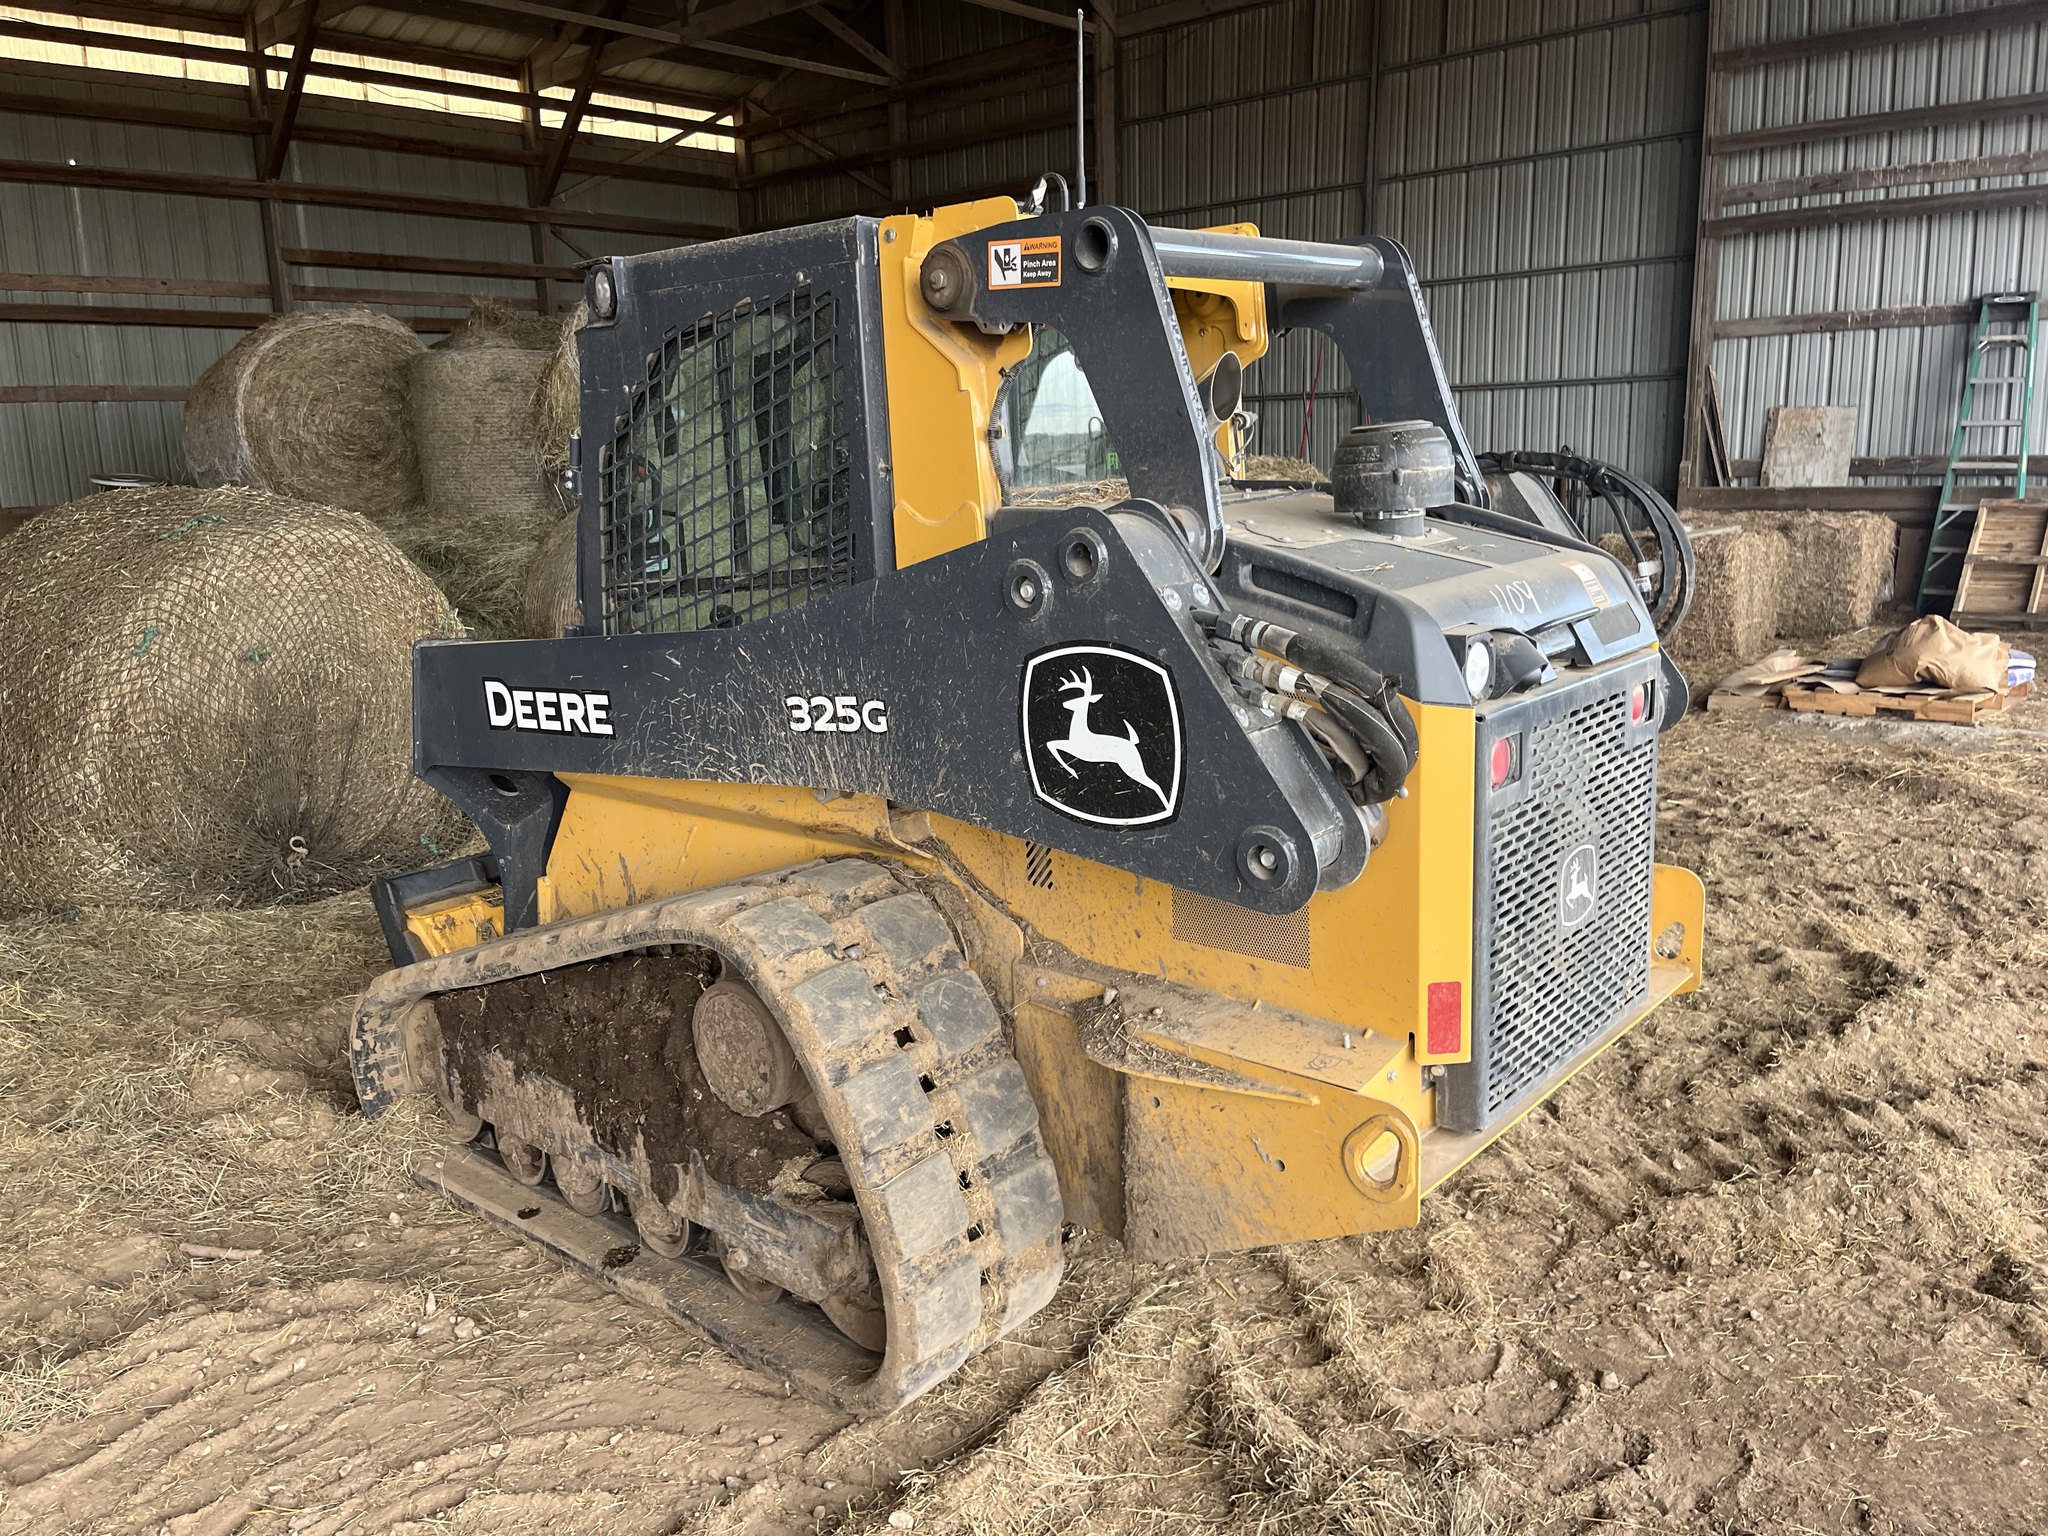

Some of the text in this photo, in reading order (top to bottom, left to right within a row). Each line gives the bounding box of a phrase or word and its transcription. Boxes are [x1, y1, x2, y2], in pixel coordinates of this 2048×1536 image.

[1030, 242, 1058, 250] WARNING
[1023, 259, 1056, 268] Pinch Area
[1023, 270, 1051, 279] Keep Away
[484, 680, 614, 735] DEERE
[785, 695, 888, 733] 325G
